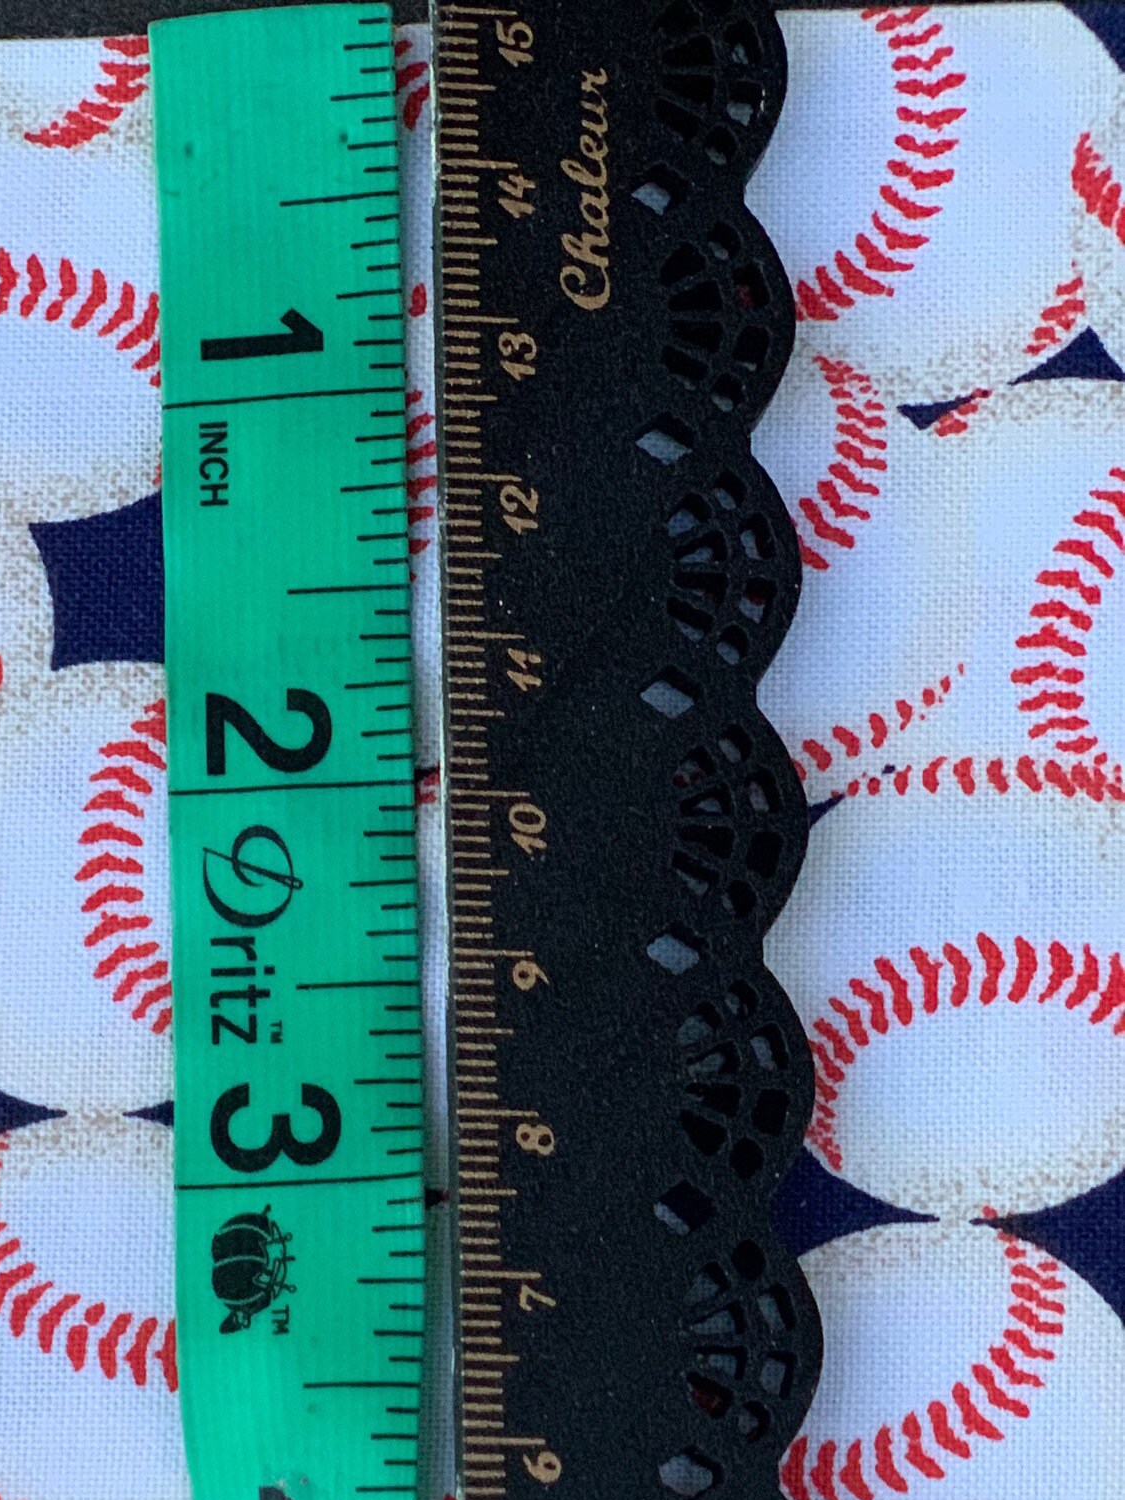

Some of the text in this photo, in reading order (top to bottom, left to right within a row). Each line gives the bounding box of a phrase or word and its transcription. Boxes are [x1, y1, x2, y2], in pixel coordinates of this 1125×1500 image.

[496, 20, 533, 67] 15
[498, 175, 536, 218] 14
[560, 68, 610, 310] Chaleur
[201, 309, 324, 361] 1
[498, 332, 537, 381] 13
[199, 422, 228, 506] INCH
[500, 485, 538, 534] 12
[507, 648, 541, 691] 11
[206, 688, 332, 776] 2
[509, 803, 547, 854] 10
[513, 960, 549, 990] 9
[210, 1083, 341, 1173] 3
[516, 1123, 555, 1155] 8
[519, 1284, 556, 1311] 7
[523, 1452, 562, 1483] 6
